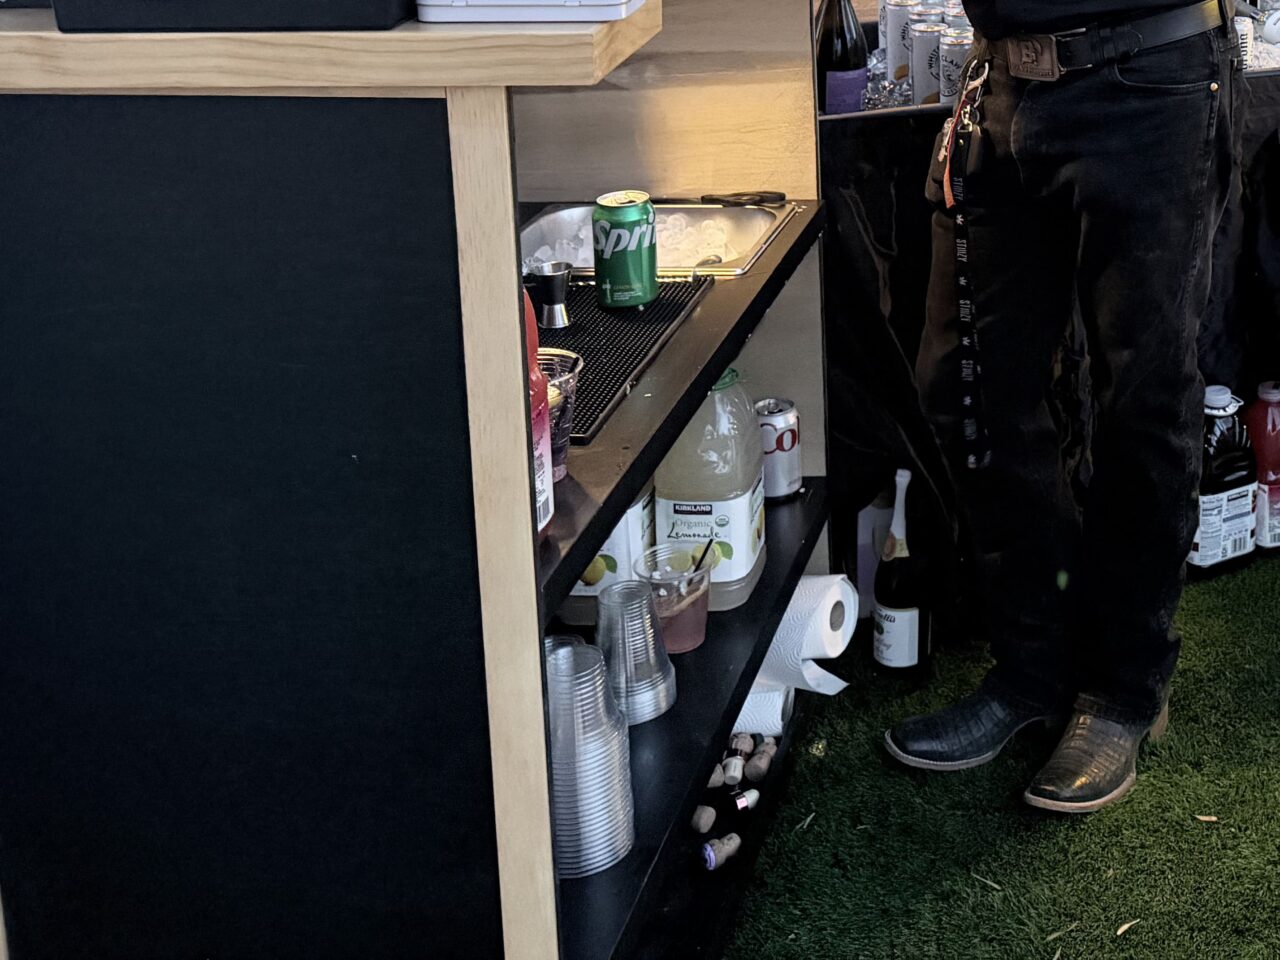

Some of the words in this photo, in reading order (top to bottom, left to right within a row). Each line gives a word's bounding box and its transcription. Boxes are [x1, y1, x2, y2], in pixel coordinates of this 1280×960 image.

[674, 505, 712, 513] KIRKLAND
[667, 521, 722, 539] Lemonade
[674, 518, 713, 530] Organic
